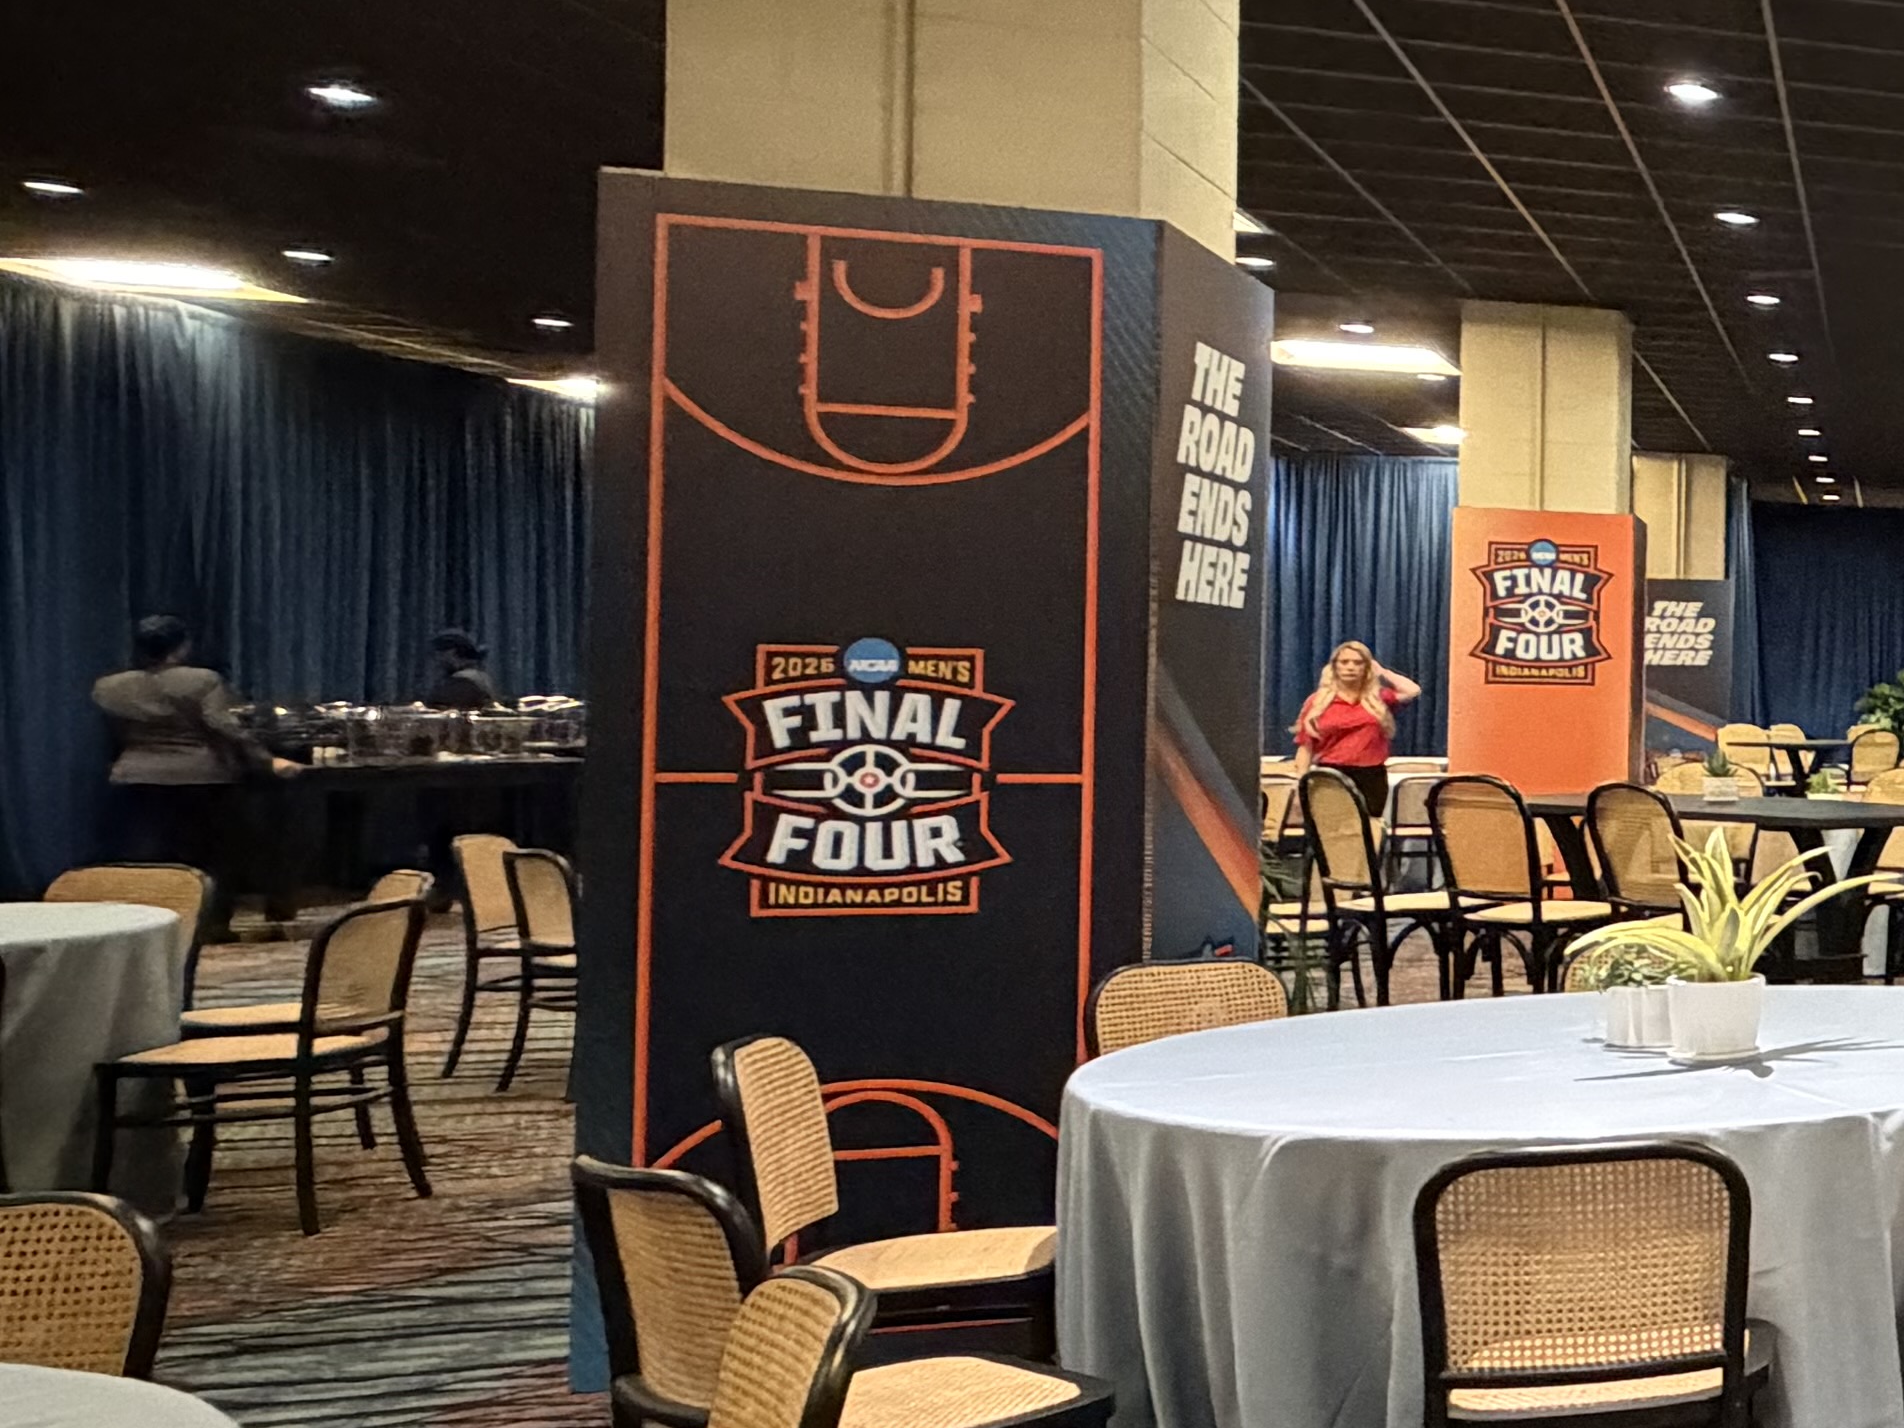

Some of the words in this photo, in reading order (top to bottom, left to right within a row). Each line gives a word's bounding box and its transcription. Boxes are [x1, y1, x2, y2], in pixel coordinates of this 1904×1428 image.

[1191, 341, 1246, 417] THE
[1176, 403, 1255, 483] ROAD
[1177, 473, 1252, 547] ENDS
[1175, 539, 1251, 609] HERE
[1493, 567, 1588, 600] FINAL
[1652, 600, 1704, 617] THE
[1645, 617, 1716, 633] ROAD
[1495, 629, 1586, 660] FOUR
[1645, 633, 1715, 649] ENDS
[771, 656, 836, 679] 2026
[848, 659, 899, 672] NCAA
[907, 659, 971, 682] MEN'S
[1495, 664, 1586, 678] INDIANAPOLIS
[1645, 649, 1714, 666] HERE
[763, 690, 967, 750] FINAL
[766, 813, 966, 871] FOUR
[768, 880, 964, 906] INDIANAPOLIS
